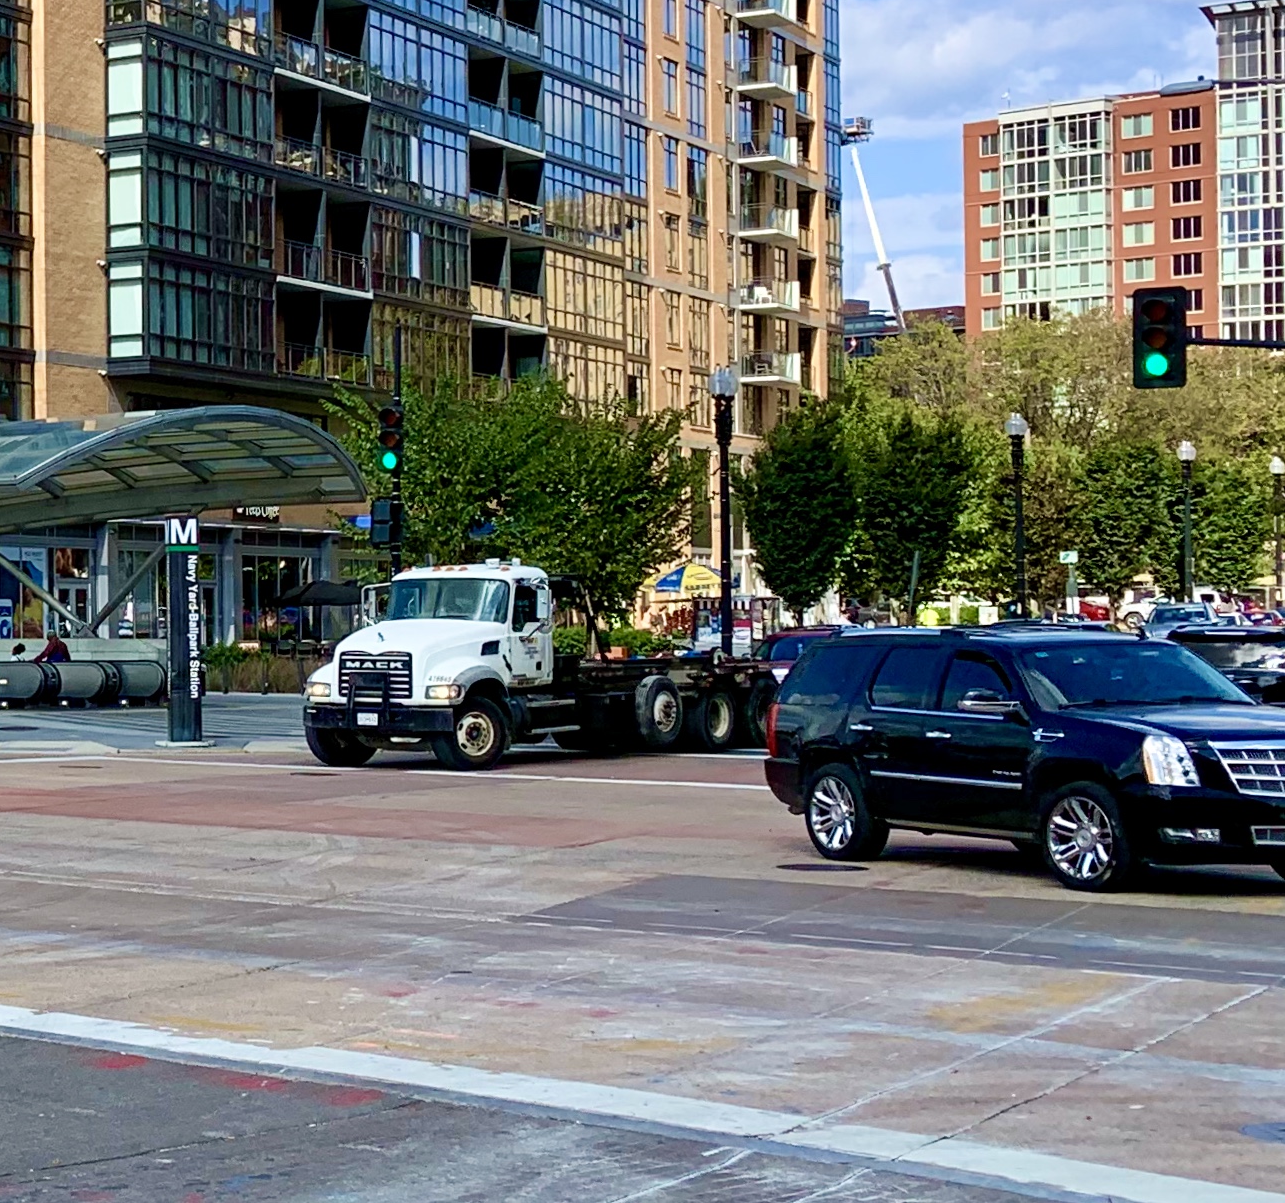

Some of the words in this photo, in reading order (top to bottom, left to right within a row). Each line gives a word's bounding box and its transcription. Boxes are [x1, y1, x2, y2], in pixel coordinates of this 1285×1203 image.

[170, 518, 198, 544] M
[185, 555, 198, 583] Navy
[186, 584, 200, 659] Yard-Ballpark
[345, 660, 404, 669] MACK
[189, 660, 201, 699] Station
